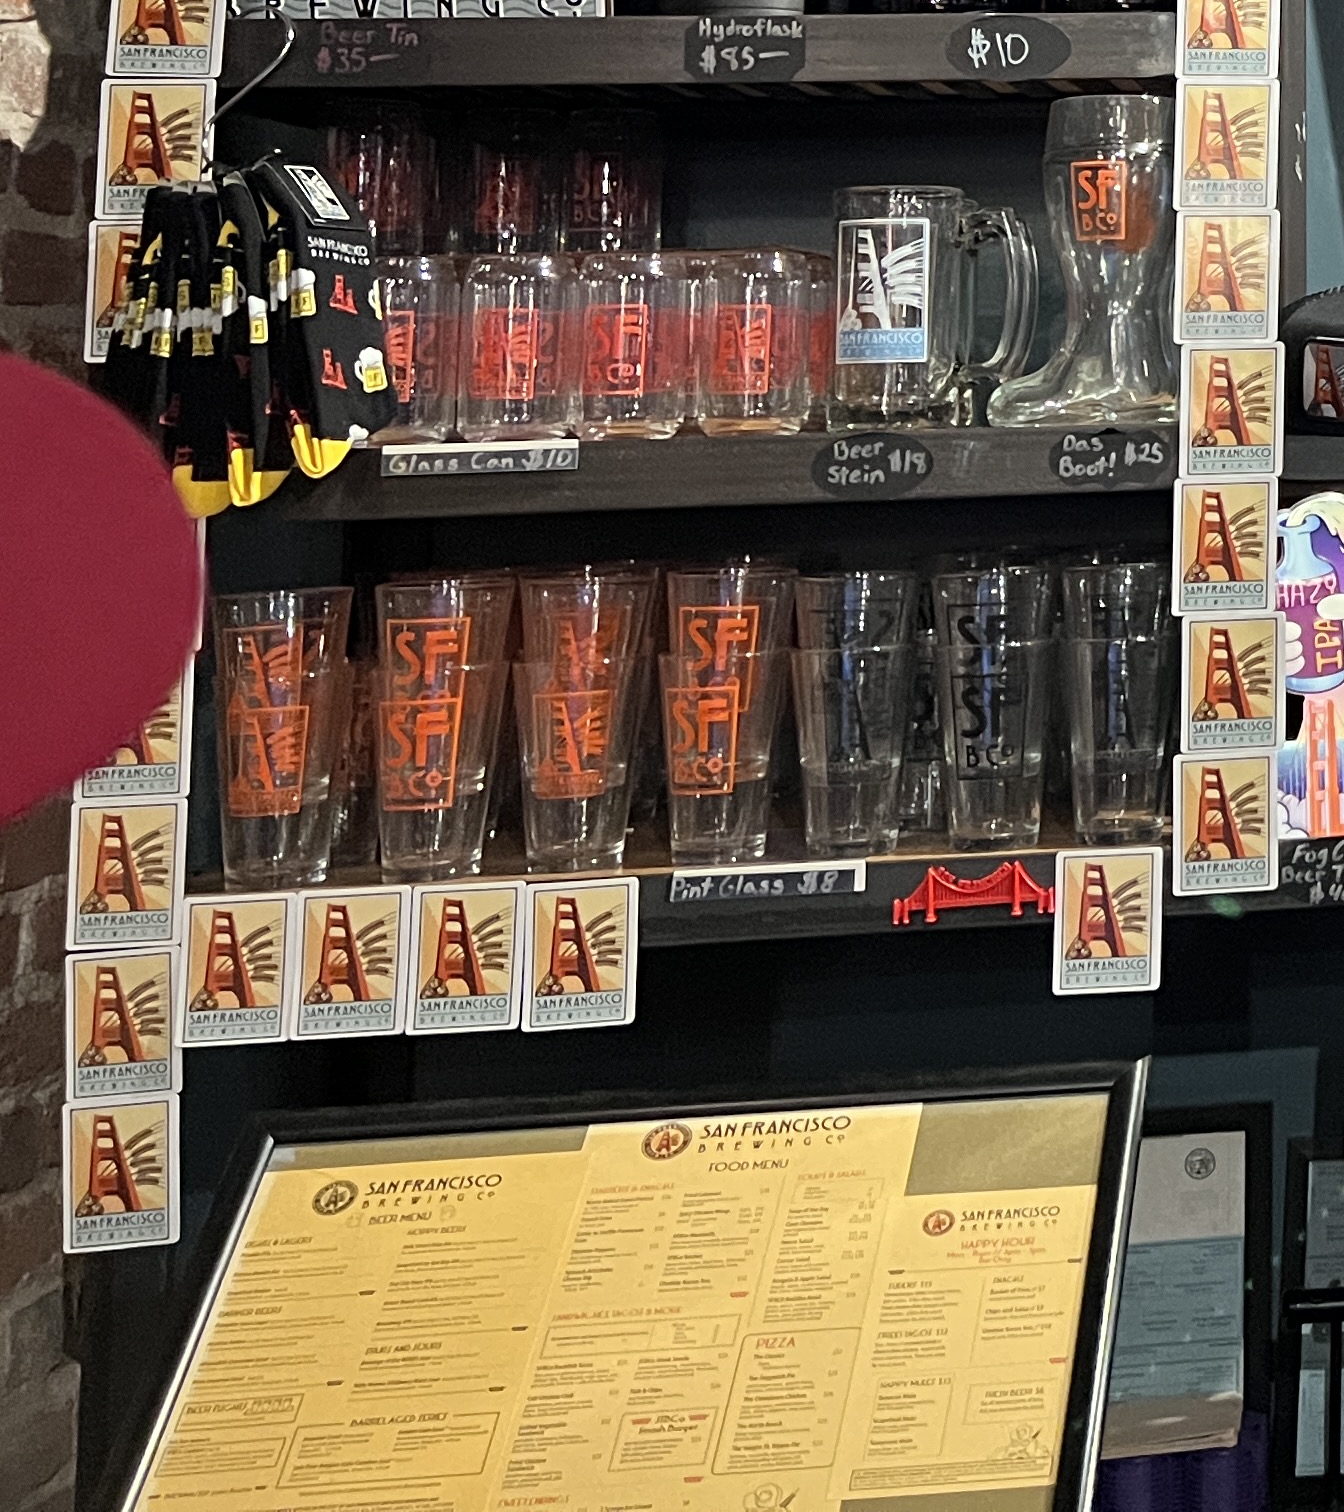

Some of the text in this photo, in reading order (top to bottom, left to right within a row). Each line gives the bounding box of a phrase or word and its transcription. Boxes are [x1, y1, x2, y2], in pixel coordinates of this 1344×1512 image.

[700, 19, 803, 41] Hydroflask
[968, 28, 1029, 68] $10
[1078, 170, 1119, 209] SF
[834, 441, 883, 461] Beer
[1063, 435, 1104, 452] Das
[389, 454, 458, 473] Glass
[1058, 452, 1116, 477] Boot!
[1277, 574, 1336, 609] HAZY
[1315, 618, 1342, 673] IPA
[1193, 720, 1273, 734] SAN FRANCISCO
[1292, 843, 1328, 868] Fog
[670, 876, 714, 902] Pint
[719, 875, 784, 898] Glass
[700, 1115, 851, 1139] SAN FRANCISCO
